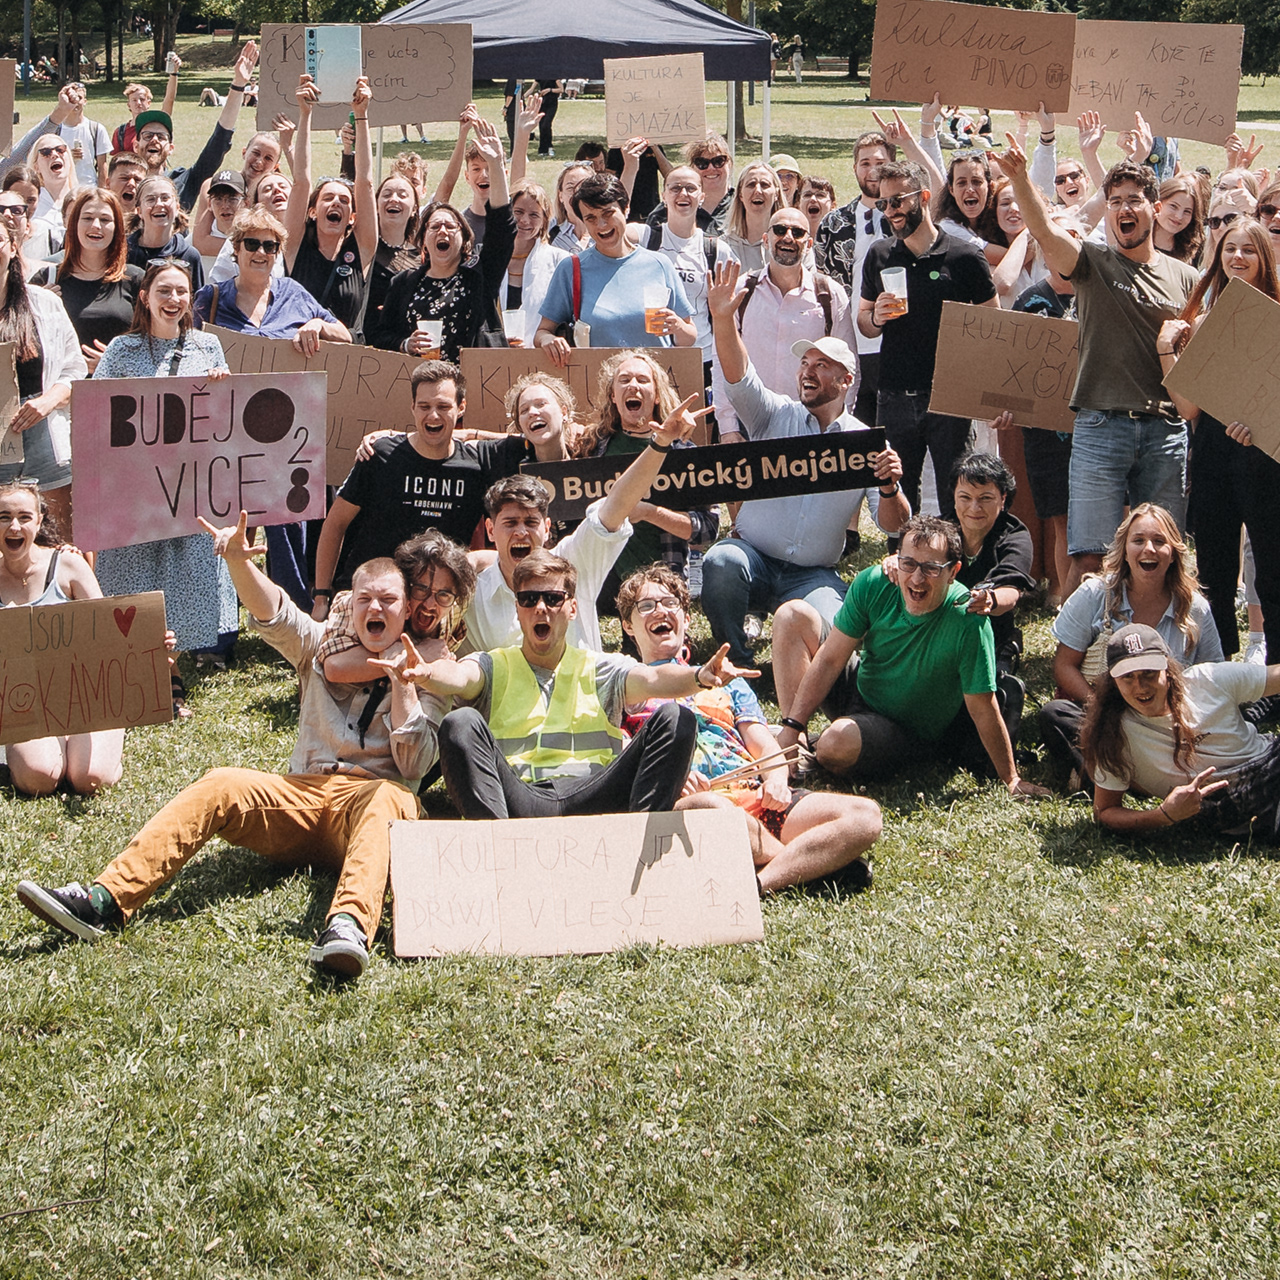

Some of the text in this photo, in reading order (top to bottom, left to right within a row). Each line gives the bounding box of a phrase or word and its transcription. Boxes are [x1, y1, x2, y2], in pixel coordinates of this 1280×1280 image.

[387, 37, 419, 59] úcta
[881, 2, 1052, 56] Kultura
[612, 66, 683, 81] KULTURA
[969, 54, 1038, 90] PIVO
[622, 92, 642, 103] JE
[616, 104, 697, 136] SMAŽÁK
[155, 453, 268, 518] VICE
[404, 475, 465, 497] ICONO
[563, 458, 753, 501] Budovický
[24, 611, 75, 654] JSOU
[37, 643, 170, 733] KÁMOŠI
[436, 834, 612, 876] KULTURA
